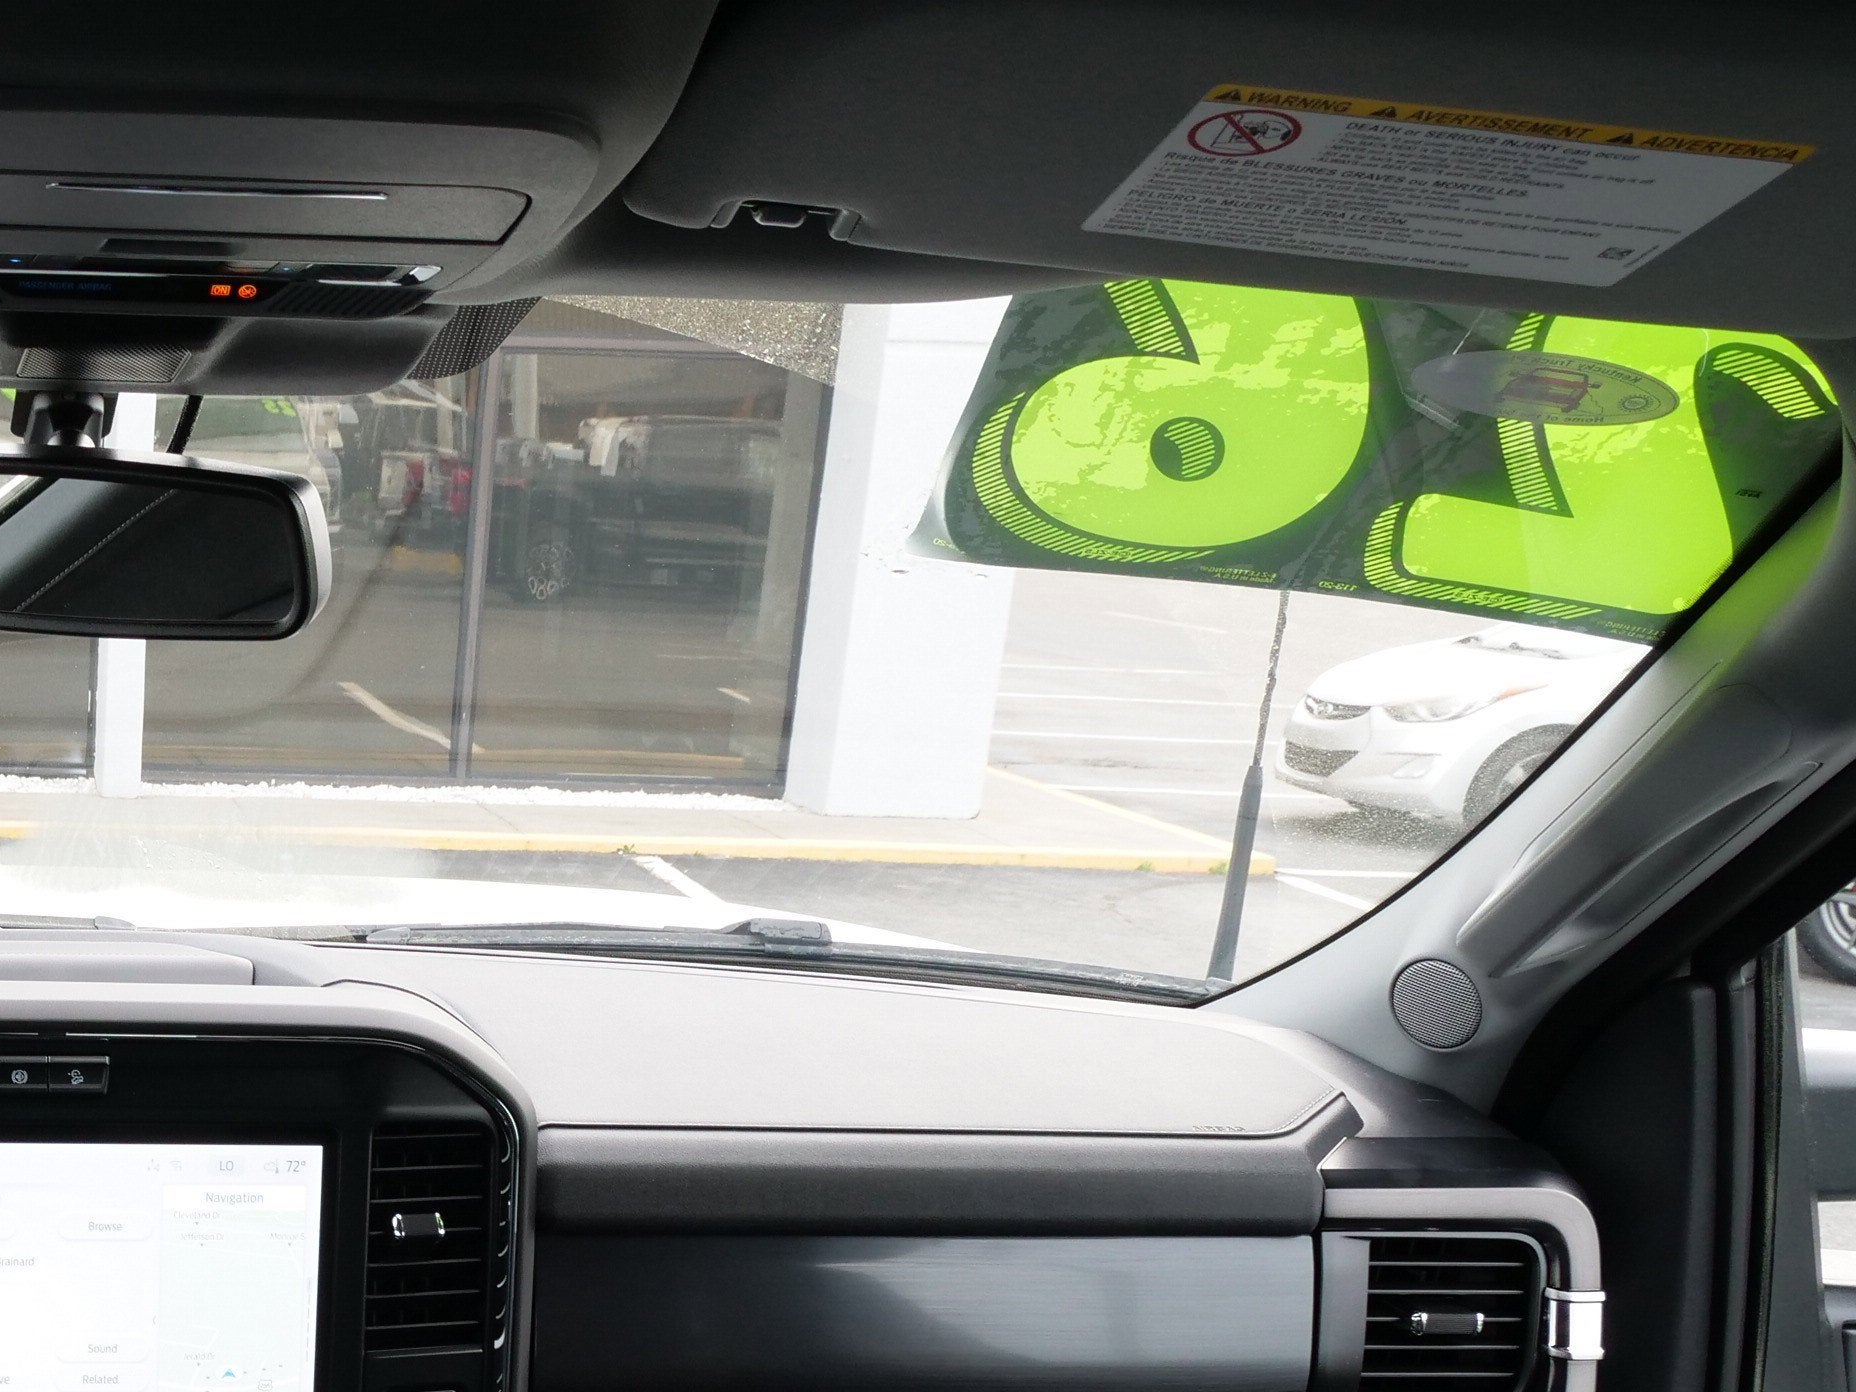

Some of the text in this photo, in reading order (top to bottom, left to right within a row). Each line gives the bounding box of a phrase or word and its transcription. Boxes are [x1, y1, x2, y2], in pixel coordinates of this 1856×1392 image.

[1248, 92, 1353, 113] WARNING
[1408, 110, 1594, 139] AVERTISSEMENT
[1641, 135, 1800, 161] ADVERTENCIA
[1242, 160, 1408, 183] BLESSURES GRAVES
[214, 285, 230, 296] ON
[219, 1160, 235, 1172] LO
[205, 1192, 264, 1205] Navigation
[87, 1221, 124, 1232] Browse
[87, 1343, 118, 1354] Sound
[82, 1374, 120, 1385] Related
